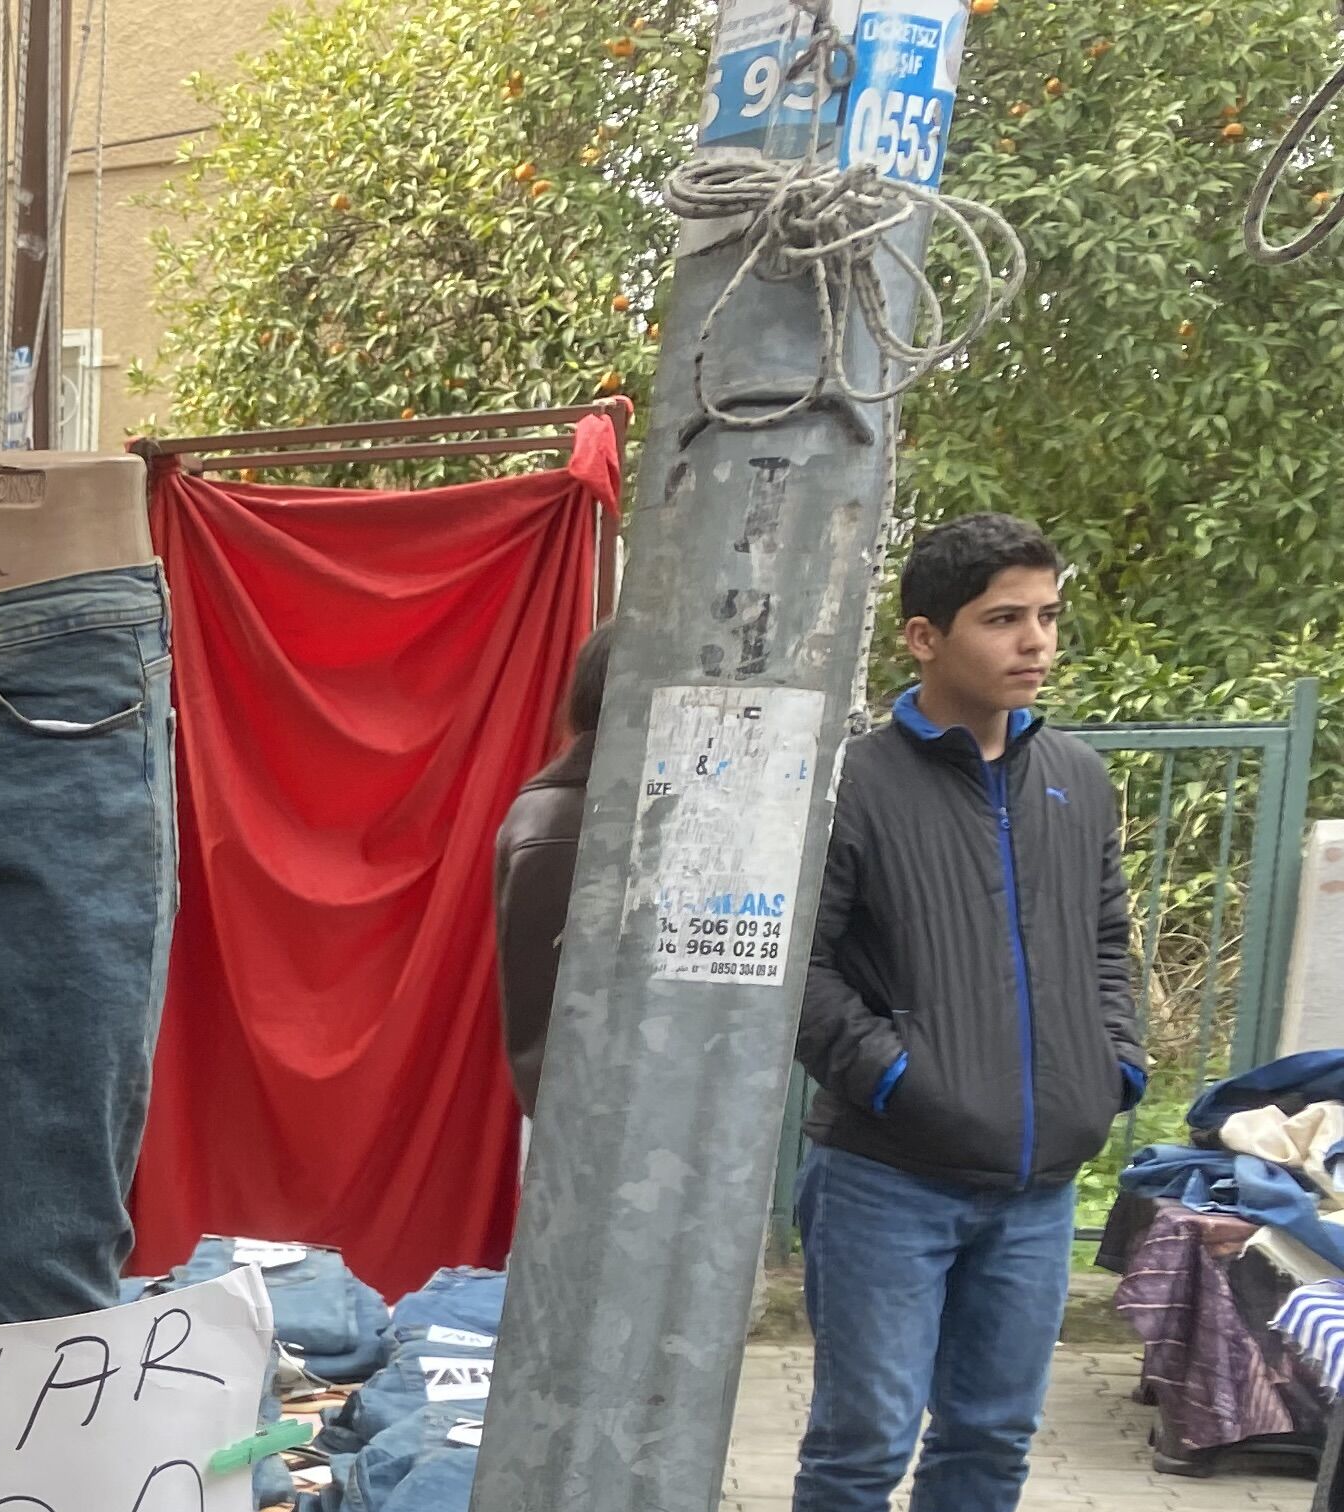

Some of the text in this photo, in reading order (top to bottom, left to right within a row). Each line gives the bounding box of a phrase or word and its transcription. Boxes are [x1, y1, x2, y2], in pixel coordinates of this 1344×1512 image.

[848, 86, 941, 182] 0553
[688, 917, 729, 936] 506
[736, 919, 759, 938] 09
[762, 921, 782, 939] 34
[686, 939, 726, 956] 964
[733, 940, 756, 958] 02
[760, 941, 779, 959] 58
[710, 961, 737, 975] 0850
